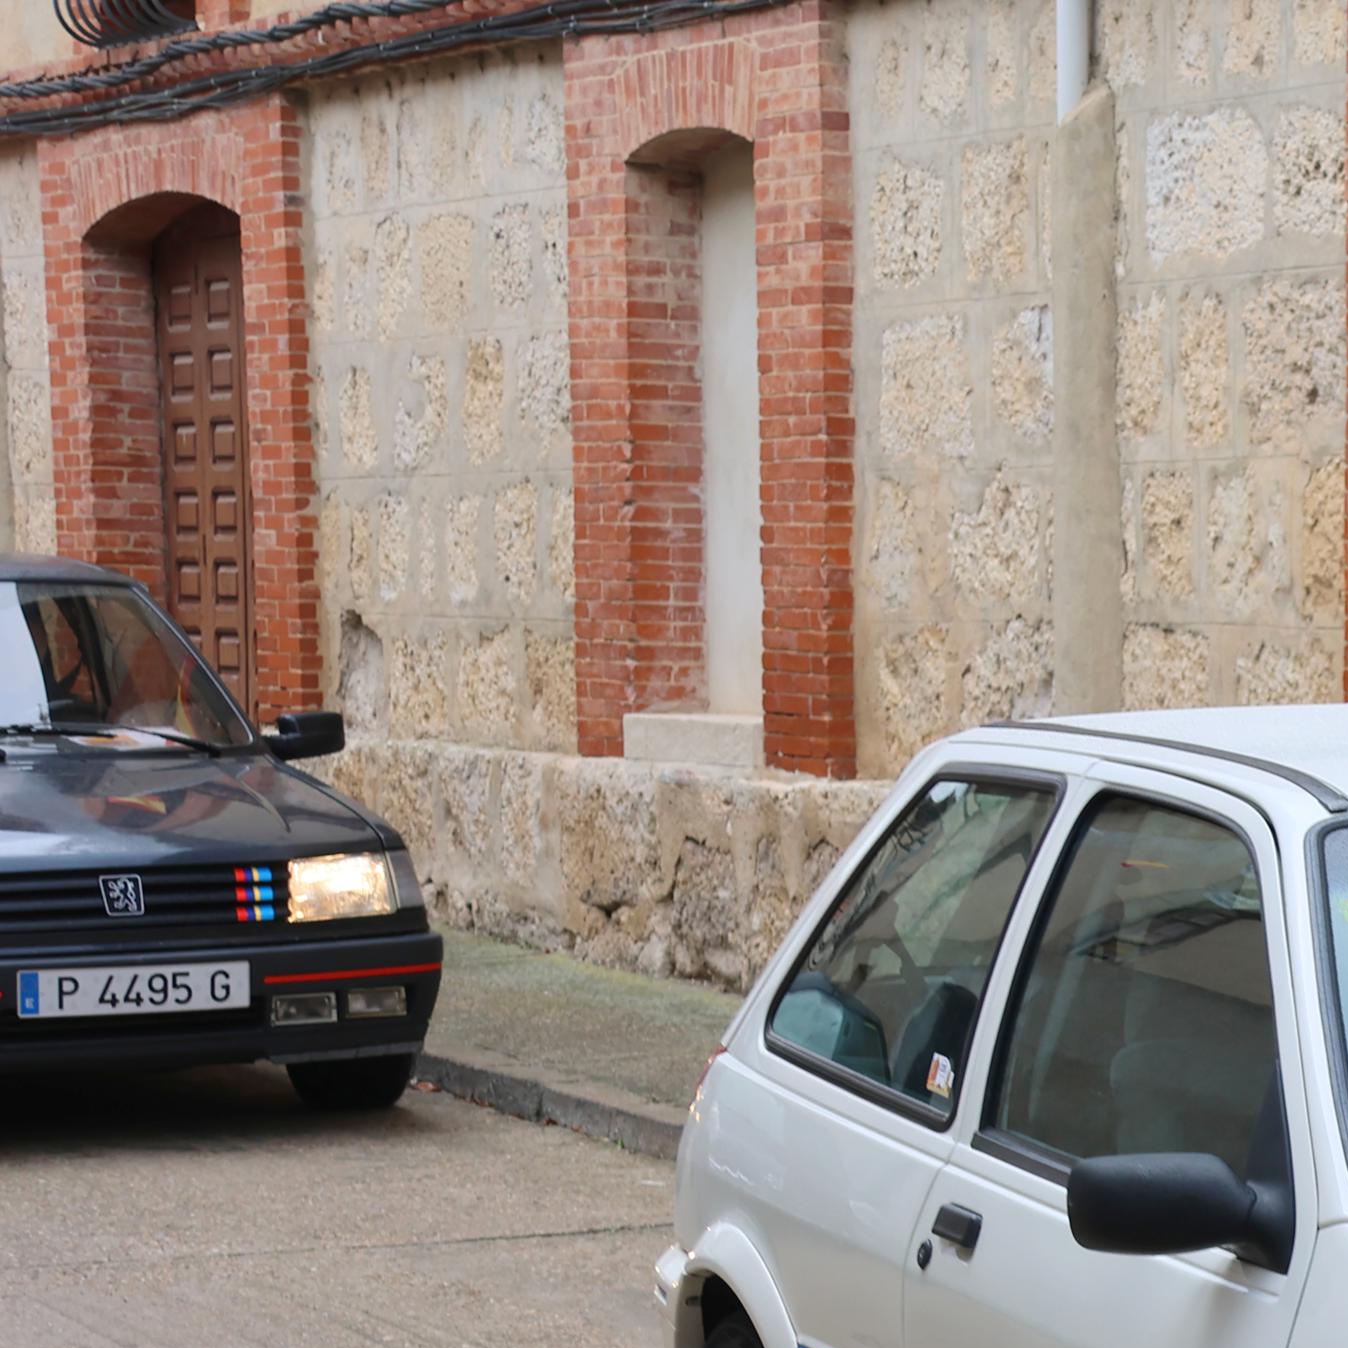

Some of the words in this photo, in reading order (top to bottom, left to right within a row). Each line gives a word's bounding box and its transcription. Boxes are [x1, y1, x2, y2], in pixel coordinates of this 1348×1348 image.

[57, 976, 80, 1010] P
[98, 972, 194, 1007] 4495
[210, 969, 232, 1003] G
